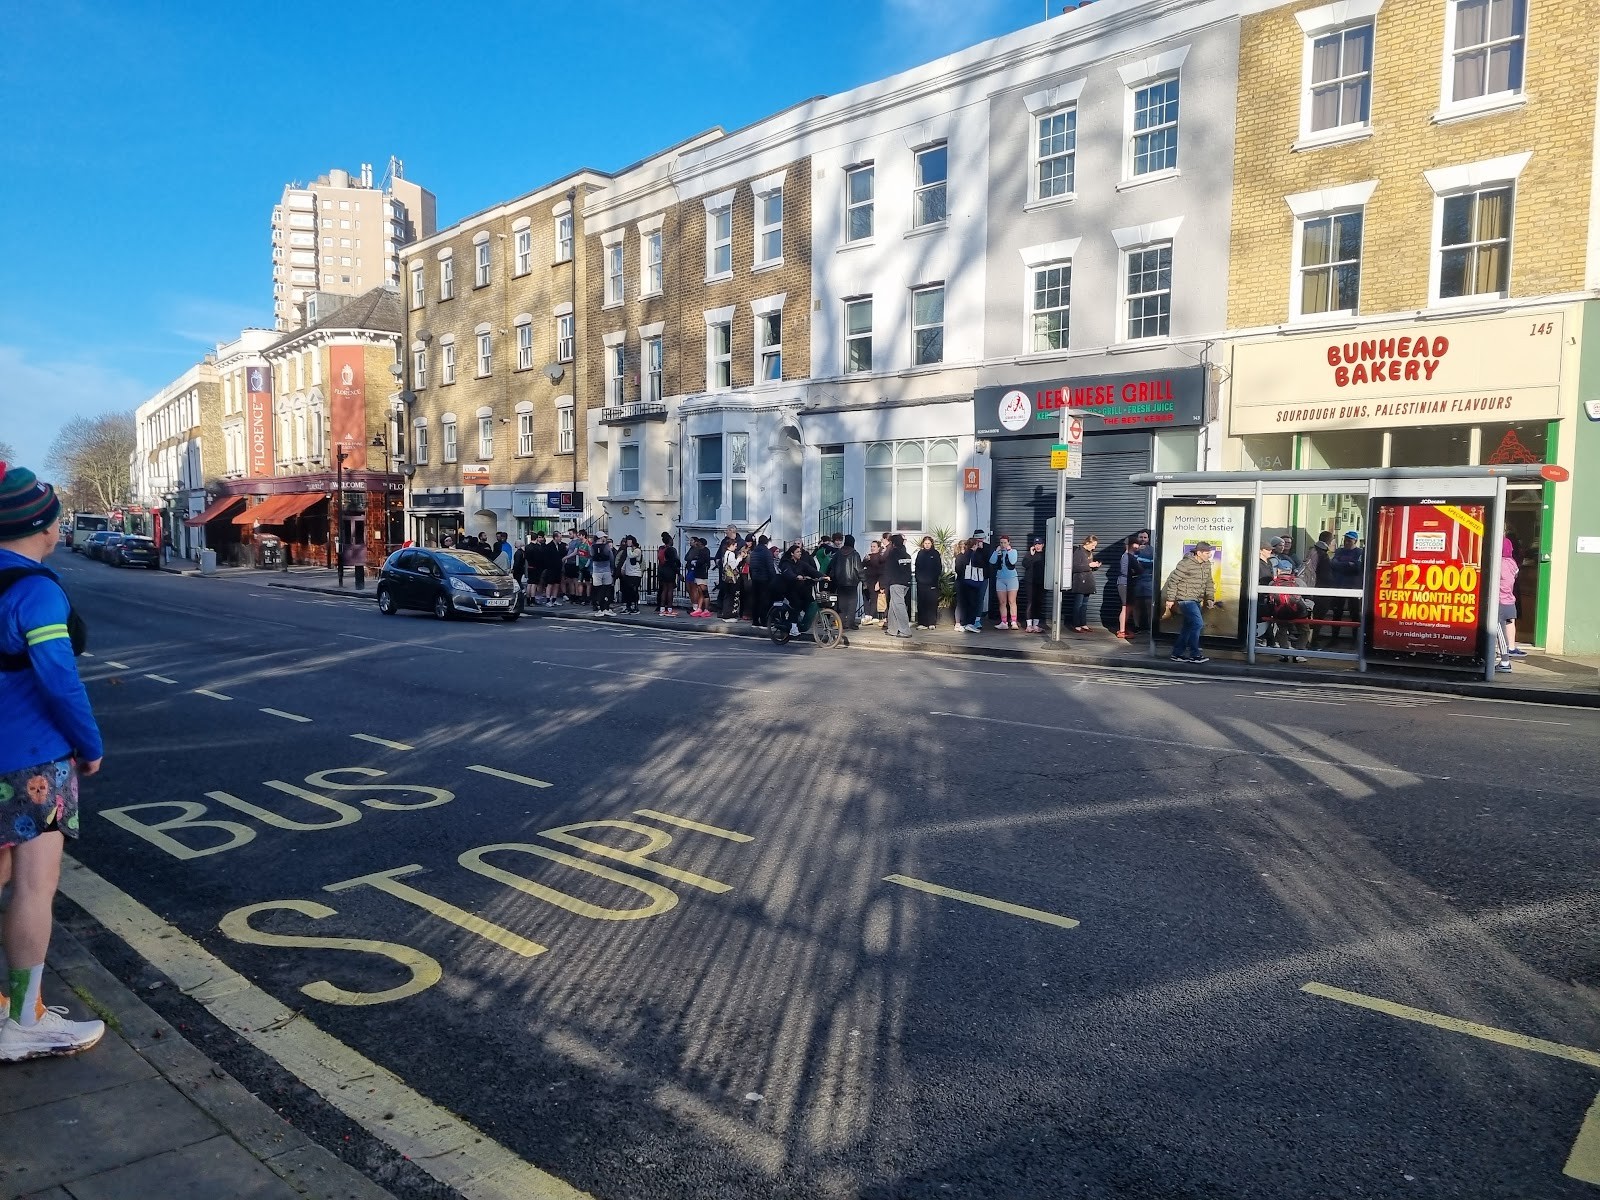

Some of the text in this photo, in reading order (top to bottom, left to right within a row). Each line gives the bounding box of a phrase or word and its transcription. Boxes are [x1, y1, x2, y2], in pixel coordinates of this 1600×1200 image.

[1529, 322, 1554, 336] 145
[1327, 336, 1449, 366] BUNHEAD
[1335, 359, 1439, 387] BAKERY
[1062, 388, 1070, 404] N
[1122, 379, 1174, 403] GRILL
[1103, 406, 1122, 416] GRILL
[1128, 403, 1151, 414] FRESH
[1152, 402, 1174, 412] JUICE
[1276, 396, 1513, 422] SOURDOUGH BUNS, PALESTINIAN FLAVOURS
[1103, 414, 1174, 425] THE BEST KEBAB
[252, 402, 265, 467] FLORENCE
[332, 481, 365, 489] WLCOME
[1175, 515, 1209, 523] Mornings
[1448, 507, 1466, 521] SPECIAL
[1379, 564, 1477, 592] £12,000
[1379, 589, 1476, 605] EVERY MONTH FOR
[1378, 602, 1476, 623] 12 MONTHS
[1395, 630, 1403, 638] by
[1441, 633, 1467, 641] January
[98, 767, 456, 860] BUS
[218, 820, 734, 1007] STOP
